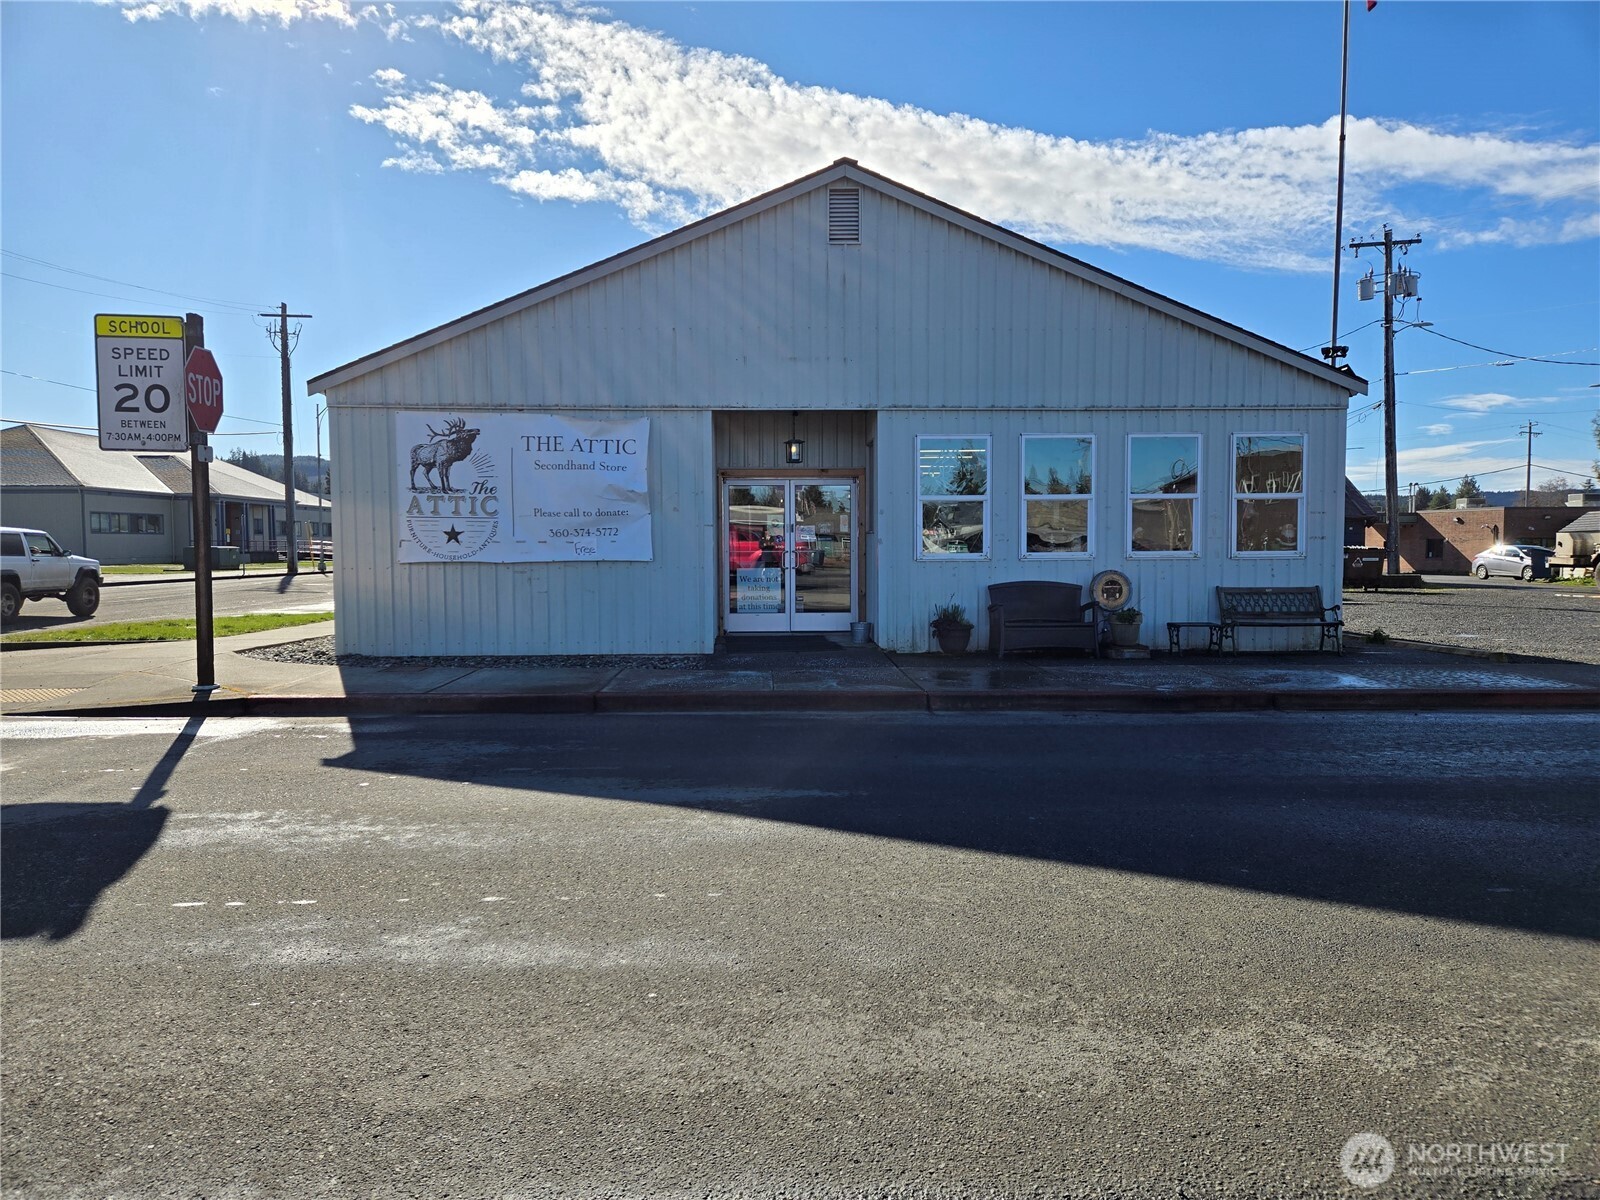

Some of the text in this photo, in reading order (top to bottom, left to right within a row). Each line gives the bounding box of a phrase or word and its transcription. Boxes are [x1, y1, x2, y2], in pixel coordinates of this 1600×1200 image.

[108, 320, 171, 334] SCHOOL
[111, 347, 170, 361] SPEED
[118, 364, 164, 378] LIMIT
[187, 372, 221, 407] STOP
[113, 383, 171, 413] 20
[120, 419, 166, 429] BETWEEN
[521, 435, 637, 455] THE ATTIC
[534, 460, 628, 472] Secondhand Store
[469, 479, 498, 495] The
[406, 495, 499, 517] ATTIC
[533, 508, 629, 518] Please call to donate:
[549, 528, 619, 538] 360-374-5772
[574, 542, 596, 554] Free
[747, 584, 771, 593] taking
